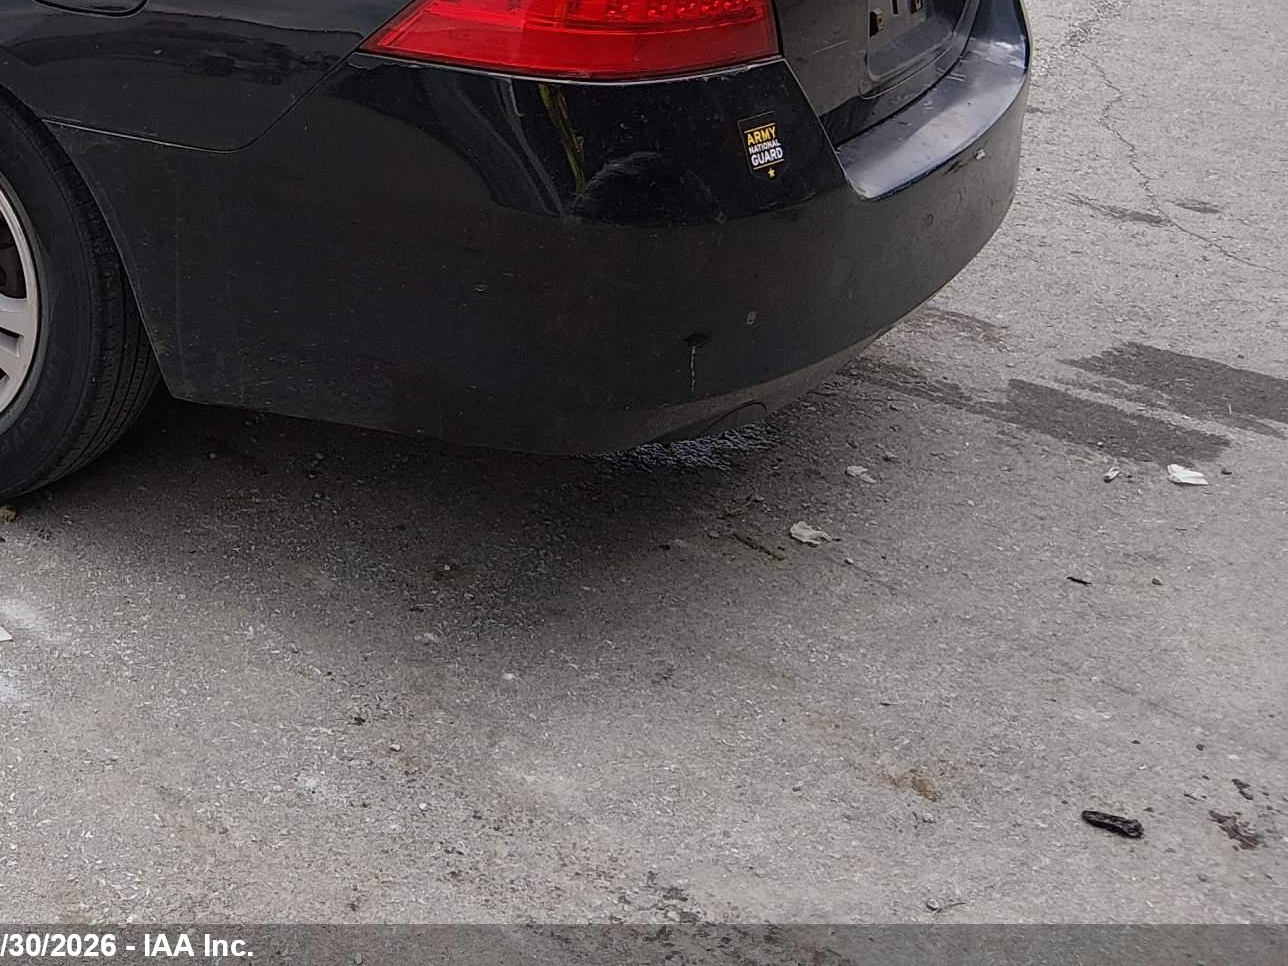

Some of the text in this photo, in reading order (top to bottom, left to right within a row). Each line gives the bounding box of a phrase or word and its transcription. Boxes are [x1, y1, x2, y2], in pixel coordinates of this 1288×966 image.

[747, 126, 775, 146] ARMY
[748, 138, 782, 155] NATIONAL
[750, 146, 783, 166] GUARD
